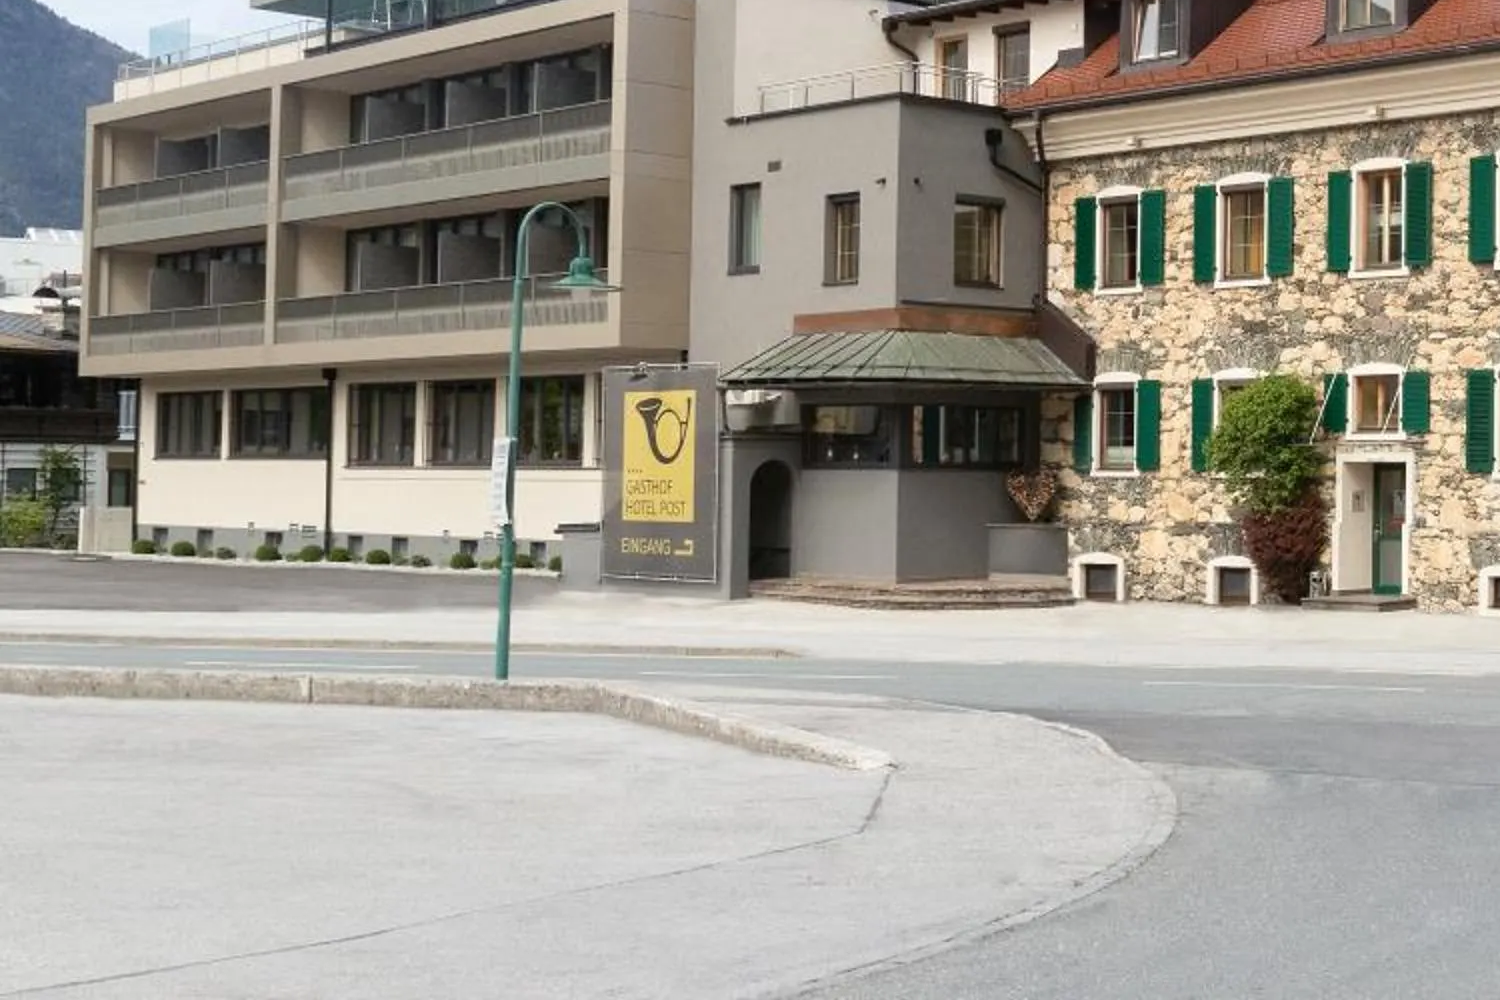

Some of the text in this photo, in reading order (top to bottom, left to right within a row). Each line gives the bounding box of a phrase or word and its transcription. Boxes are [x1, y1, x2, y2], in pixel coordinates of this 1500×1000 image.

[626, 479, 673, 495] GASTHOF
[625, 499, 686, 516] HOTEL POST
[621, 537, 671, 555] EINGANG
